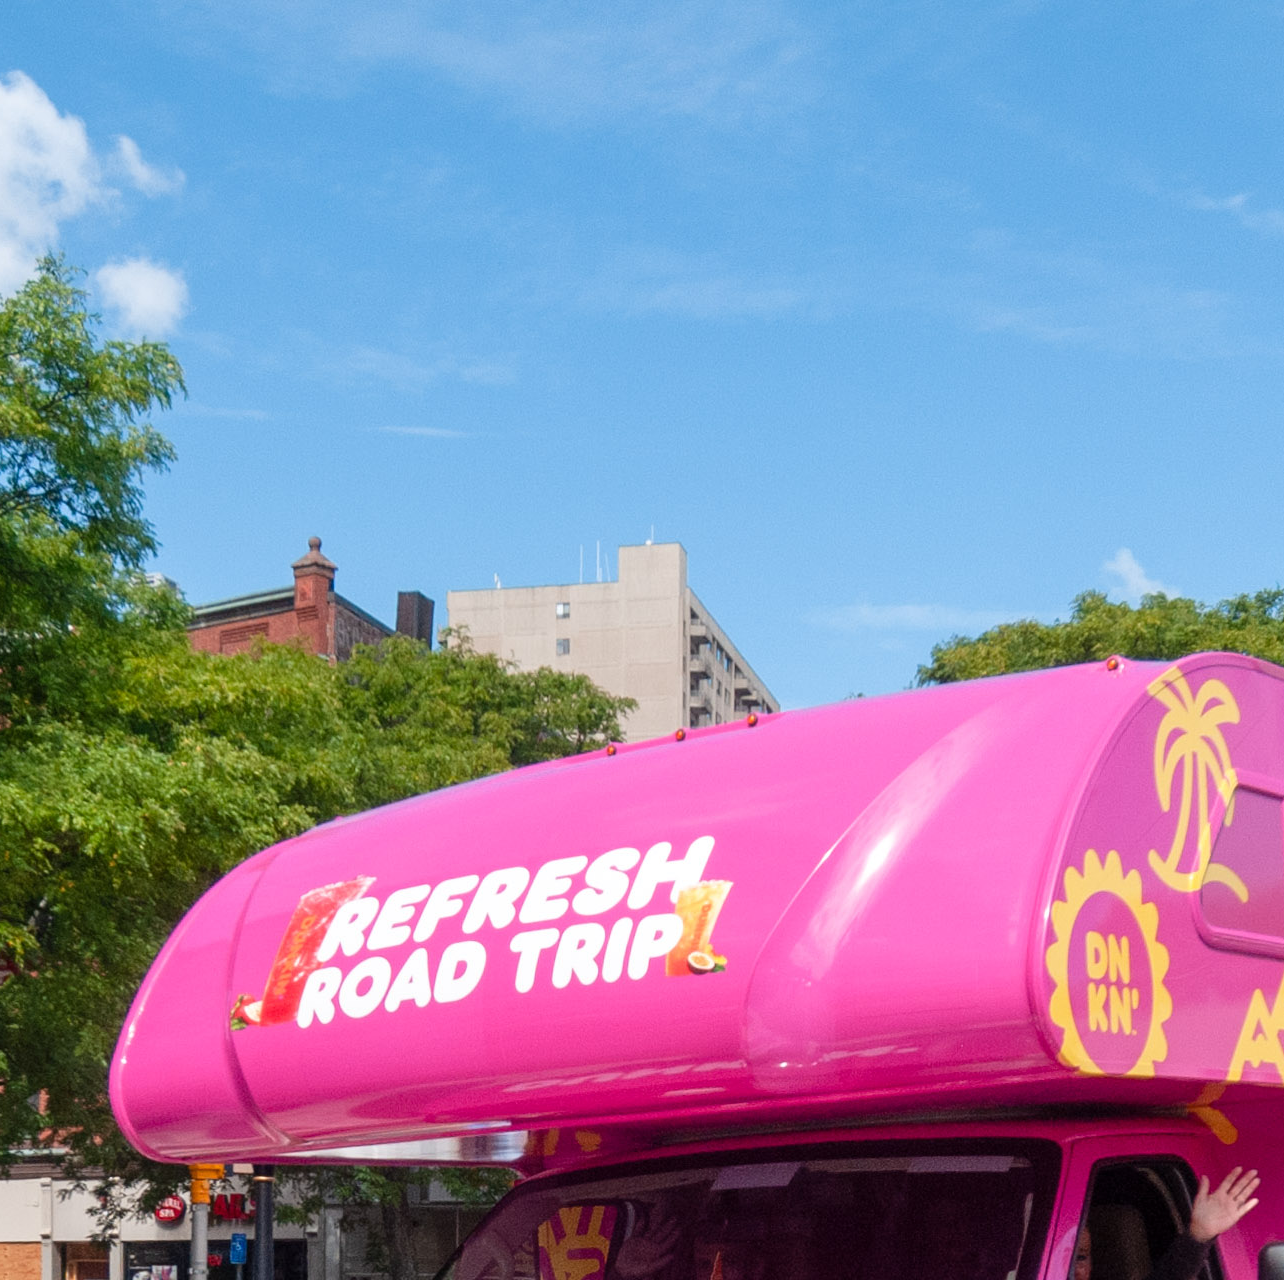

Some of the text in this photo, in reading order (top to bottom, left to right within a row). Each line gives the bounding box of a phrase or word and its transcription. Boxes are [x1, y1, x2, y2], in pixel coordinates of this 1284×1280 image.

[316, 836, 715, 962] REFRESH
[297, 913, 684, 1029] ROAD TRIP
[1085, 930, 1131, 985] DN
